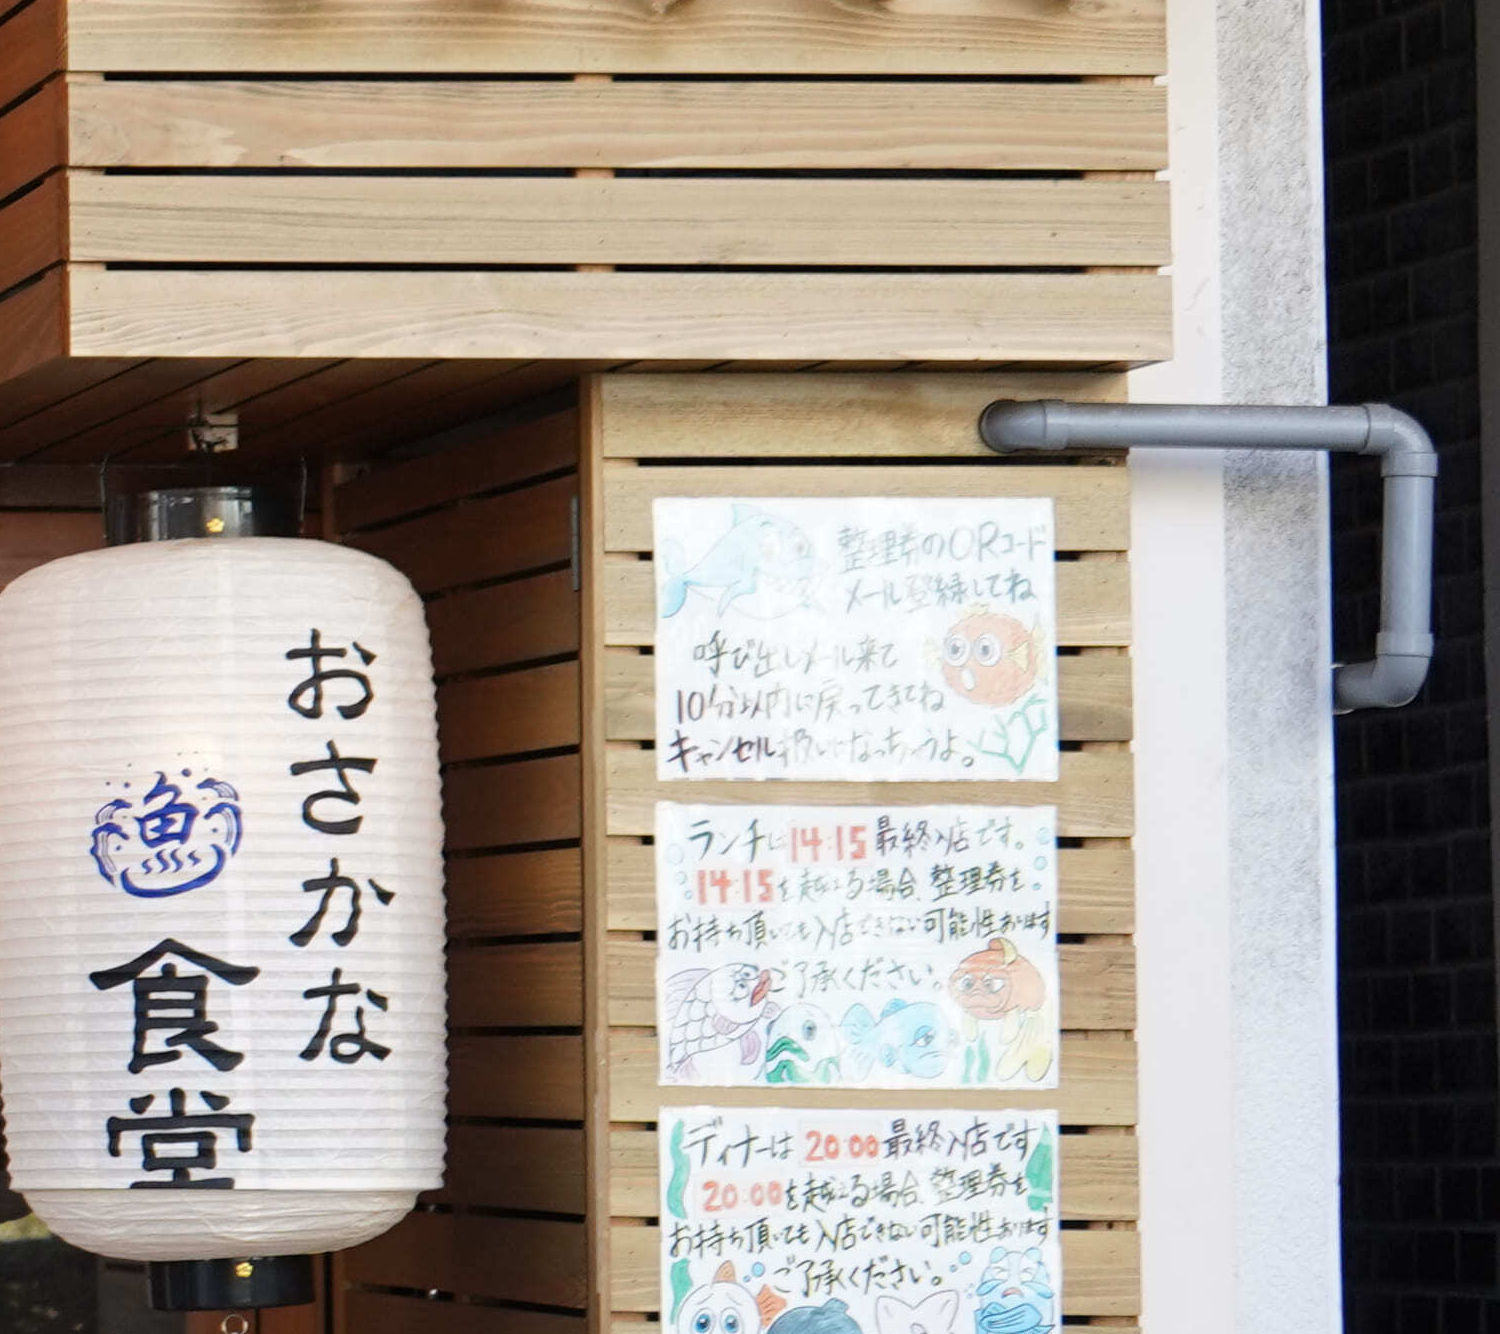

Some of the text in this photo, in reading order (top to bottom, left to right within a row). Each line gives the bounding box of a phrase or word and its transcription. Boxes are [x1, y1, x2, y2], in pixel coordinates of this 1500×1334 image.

[283, 627, 396, 1066] おさかな
[88, 937, 260, 1191] 食堂
[772, 1255, 944, 1299] ご了承ください。
